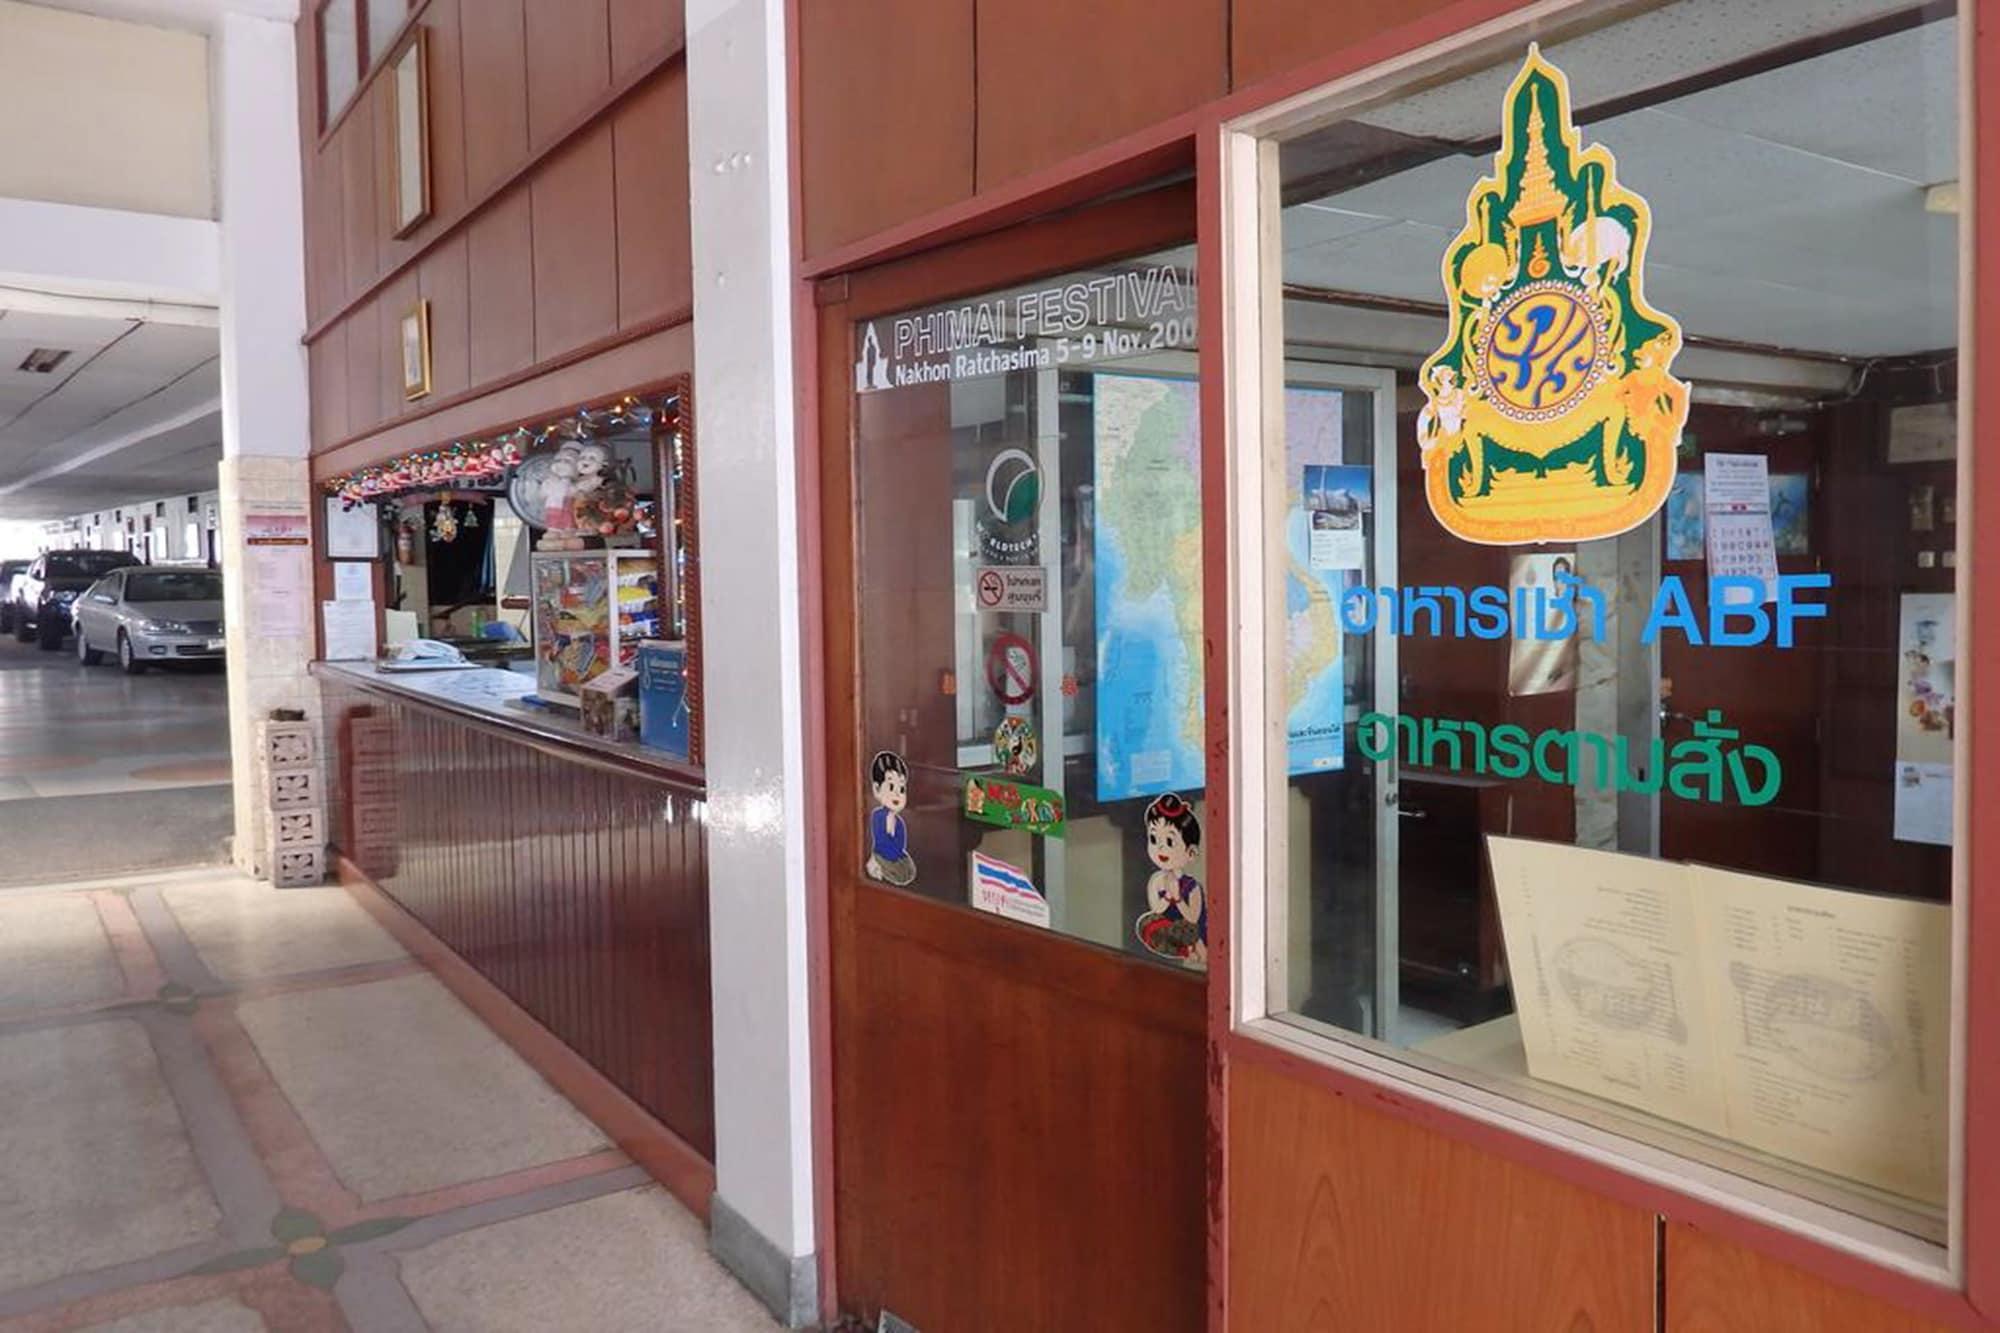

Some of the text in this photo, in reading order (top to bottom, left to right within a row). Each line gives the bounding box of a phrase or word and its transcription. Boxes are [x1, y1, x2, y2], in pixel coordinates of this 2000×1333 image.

[894, 299, 1006, 360] PHIMAI
[895, 361, 950, 387] Nakhon
[956, 345, 1049, 378] Ratchasima
[1055, 333, 1096, 363] 5-9
[1341, 570, 1832, 649] อาหารเช้า ABF
[1357, 709, 1783, 807] อาหารตามสั่ง
